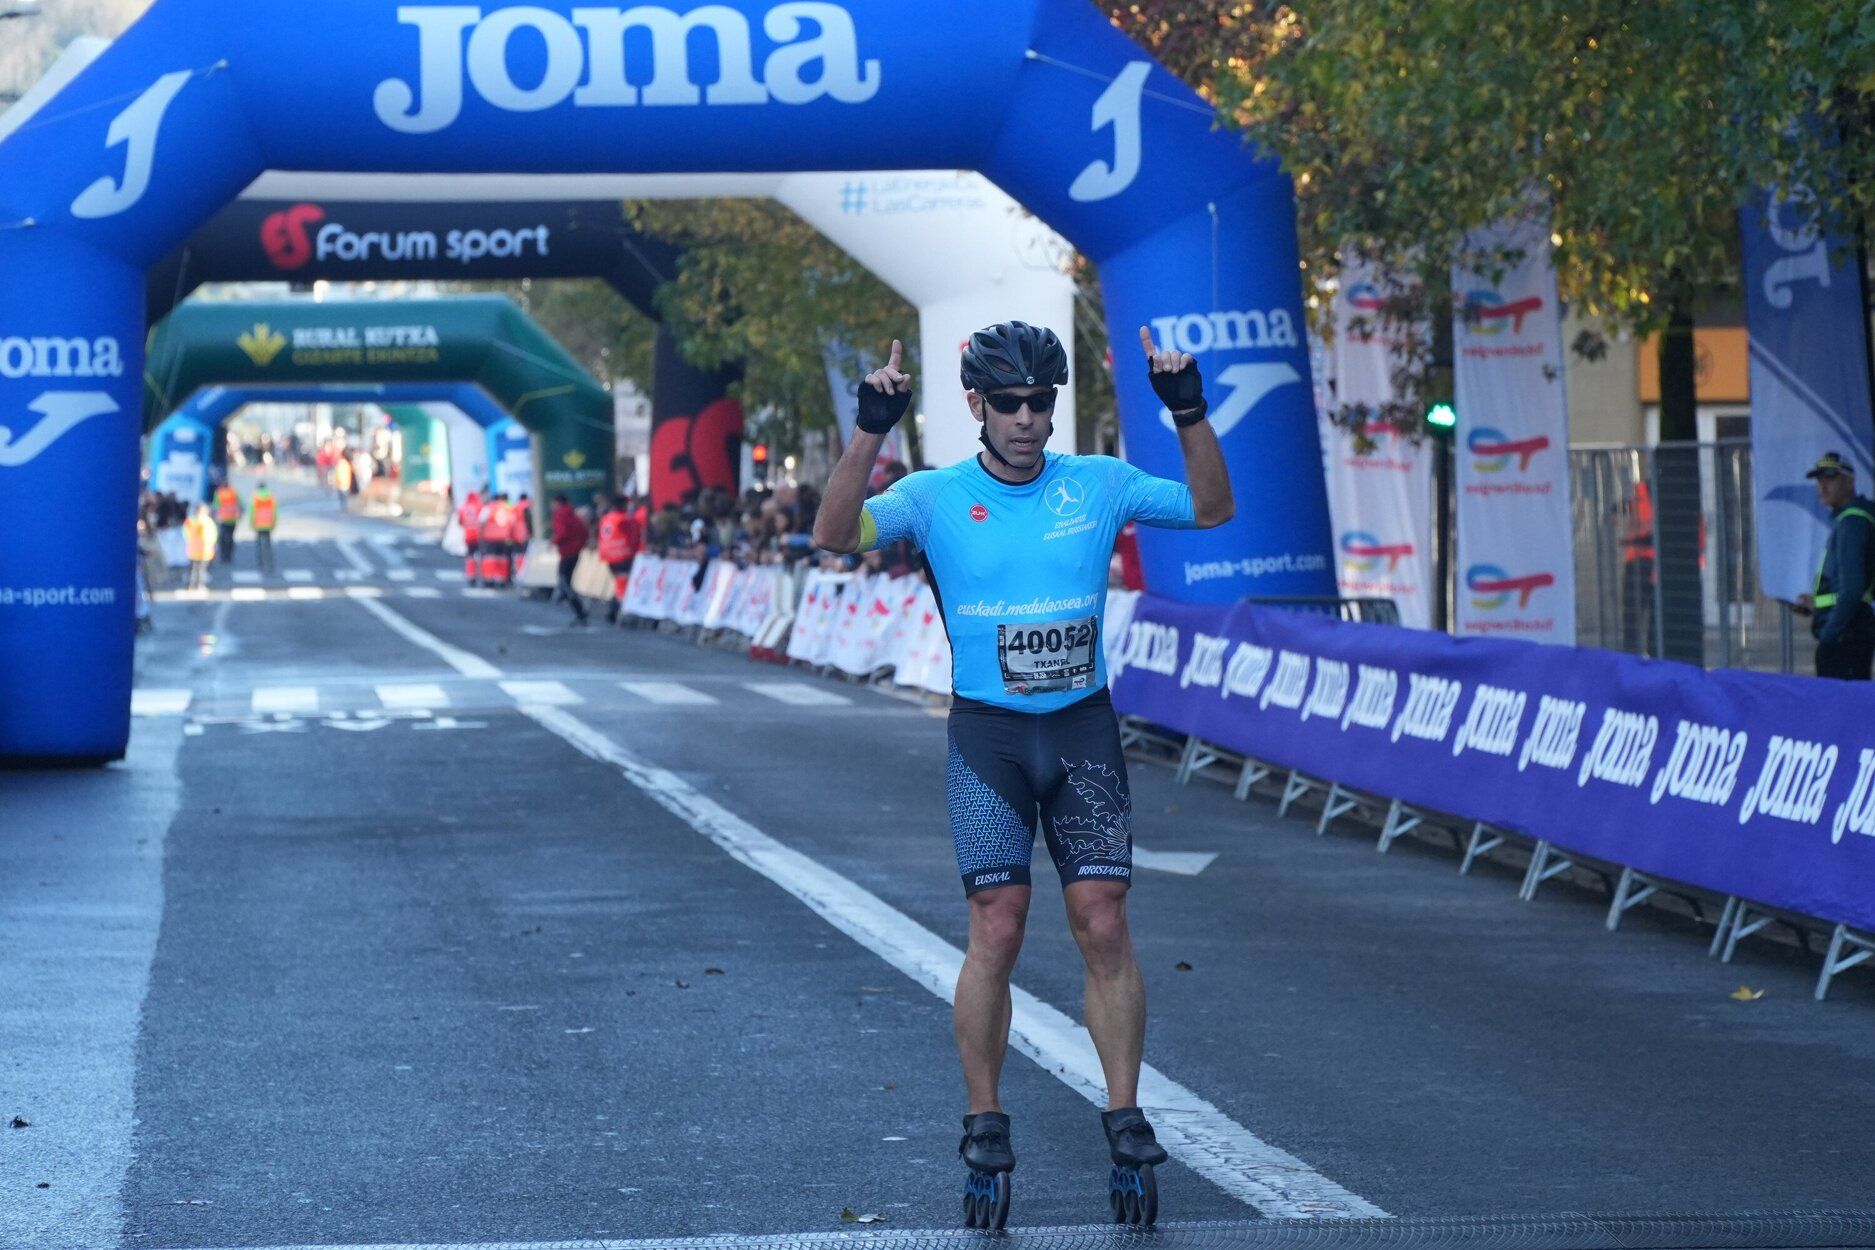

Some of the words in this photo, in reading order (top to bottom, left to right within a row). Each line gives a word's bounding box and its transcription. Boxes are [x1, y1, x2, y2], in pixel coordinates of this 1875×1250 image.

[373, 1, 882, 133] Joma
[446, 224, 550, 265] sport
[0, 335, 123, 378] oma
[1184, 552, 1326, 585] joma-sport.com
[0, 584, 115, 608] a-sport.com
[957, 592, 1099, 618] euskadi.medulaosea.org
[1008, 624, 1091, 655] 40052
[1391, 672, 1462, 744] Joma
[1452, 683, 1527, 757] Joma
[1518, 694, 1587, 772] Joma
[1578, 707, 1659, 787] Joma
[1650, 719, 1748, 806] Joma
[1739, 734, 1839, 825] Joma
[1831, 748, 1875, 845] Jo
[975, 871, 1011, 886] EUSKAL
